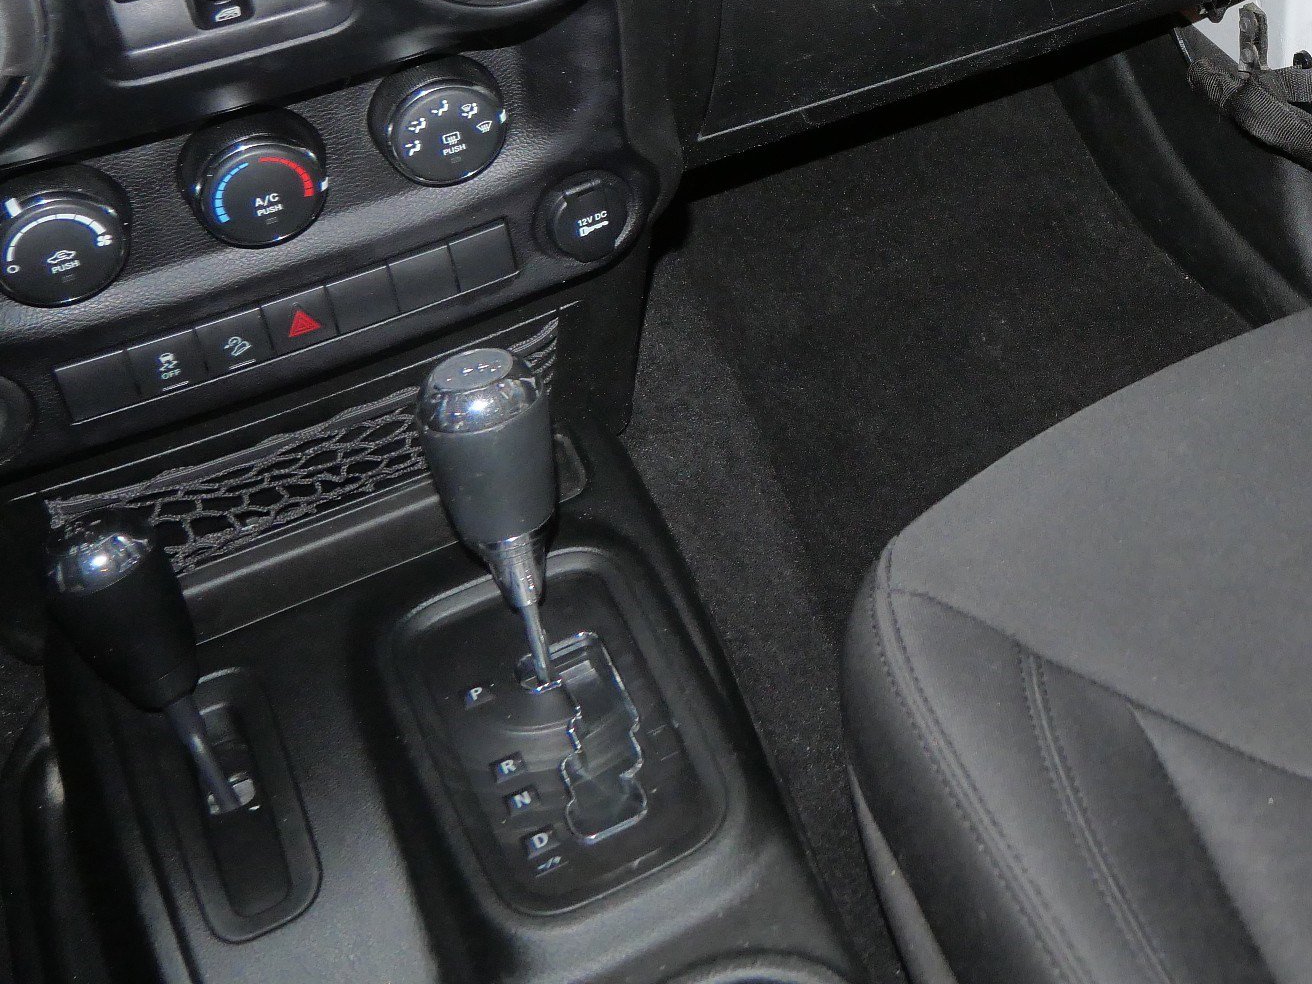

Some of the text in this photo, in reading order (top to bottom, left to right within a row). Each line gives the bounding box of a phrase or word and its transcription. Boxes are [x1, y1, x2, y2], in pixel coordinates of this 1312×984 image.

[442, 143, 467, 156] PUSH
[255, 193, 279, 207] A/C
[256, 203, 284, 217] PUSH
[577, 210, 608, 227] 12V DC
[51, 260, 81, 274] PUSH
[161, 368, 181, 380] OFF
[470, 686, 483, 701] P
[500, 759, 517, 774] R
[513, 791, 531, 809] N
[531, 832, 549, 849] D
